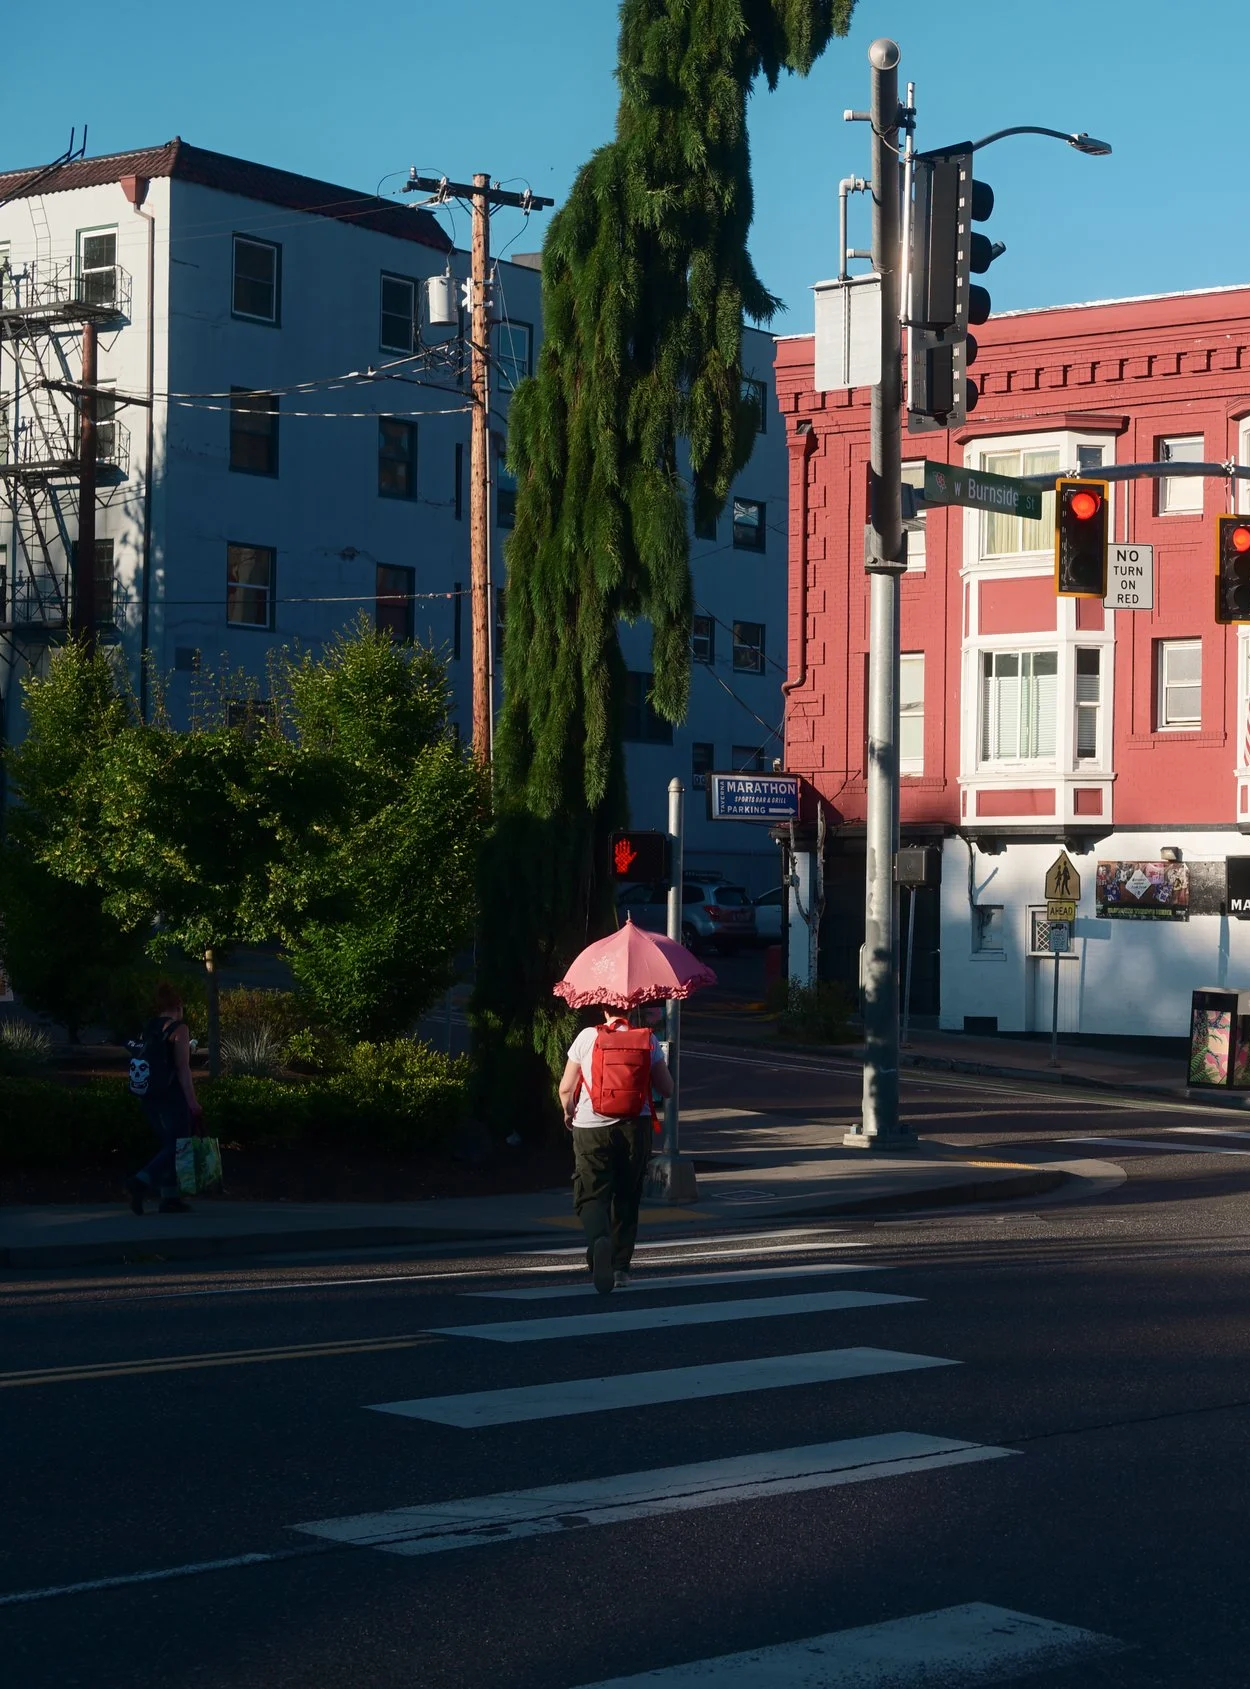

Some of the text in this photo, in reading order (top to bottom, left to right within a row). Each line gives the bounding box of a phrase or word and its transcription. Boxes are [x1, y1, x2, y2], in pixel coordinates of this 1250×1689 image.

[954, 478, 1035, 510] W Burnside St
[1116, 549, 1139, 562] NO
[1113, 565, 1143, 576] TURN
[1120, 579, 1136, 590] ON
[1117, 593, 1139, 604] RED
[726, 781, 796, 795] MARATHON
[727, 805, 766, 814] PARKING
[1050, 906, 1073, 915] AHEAD
